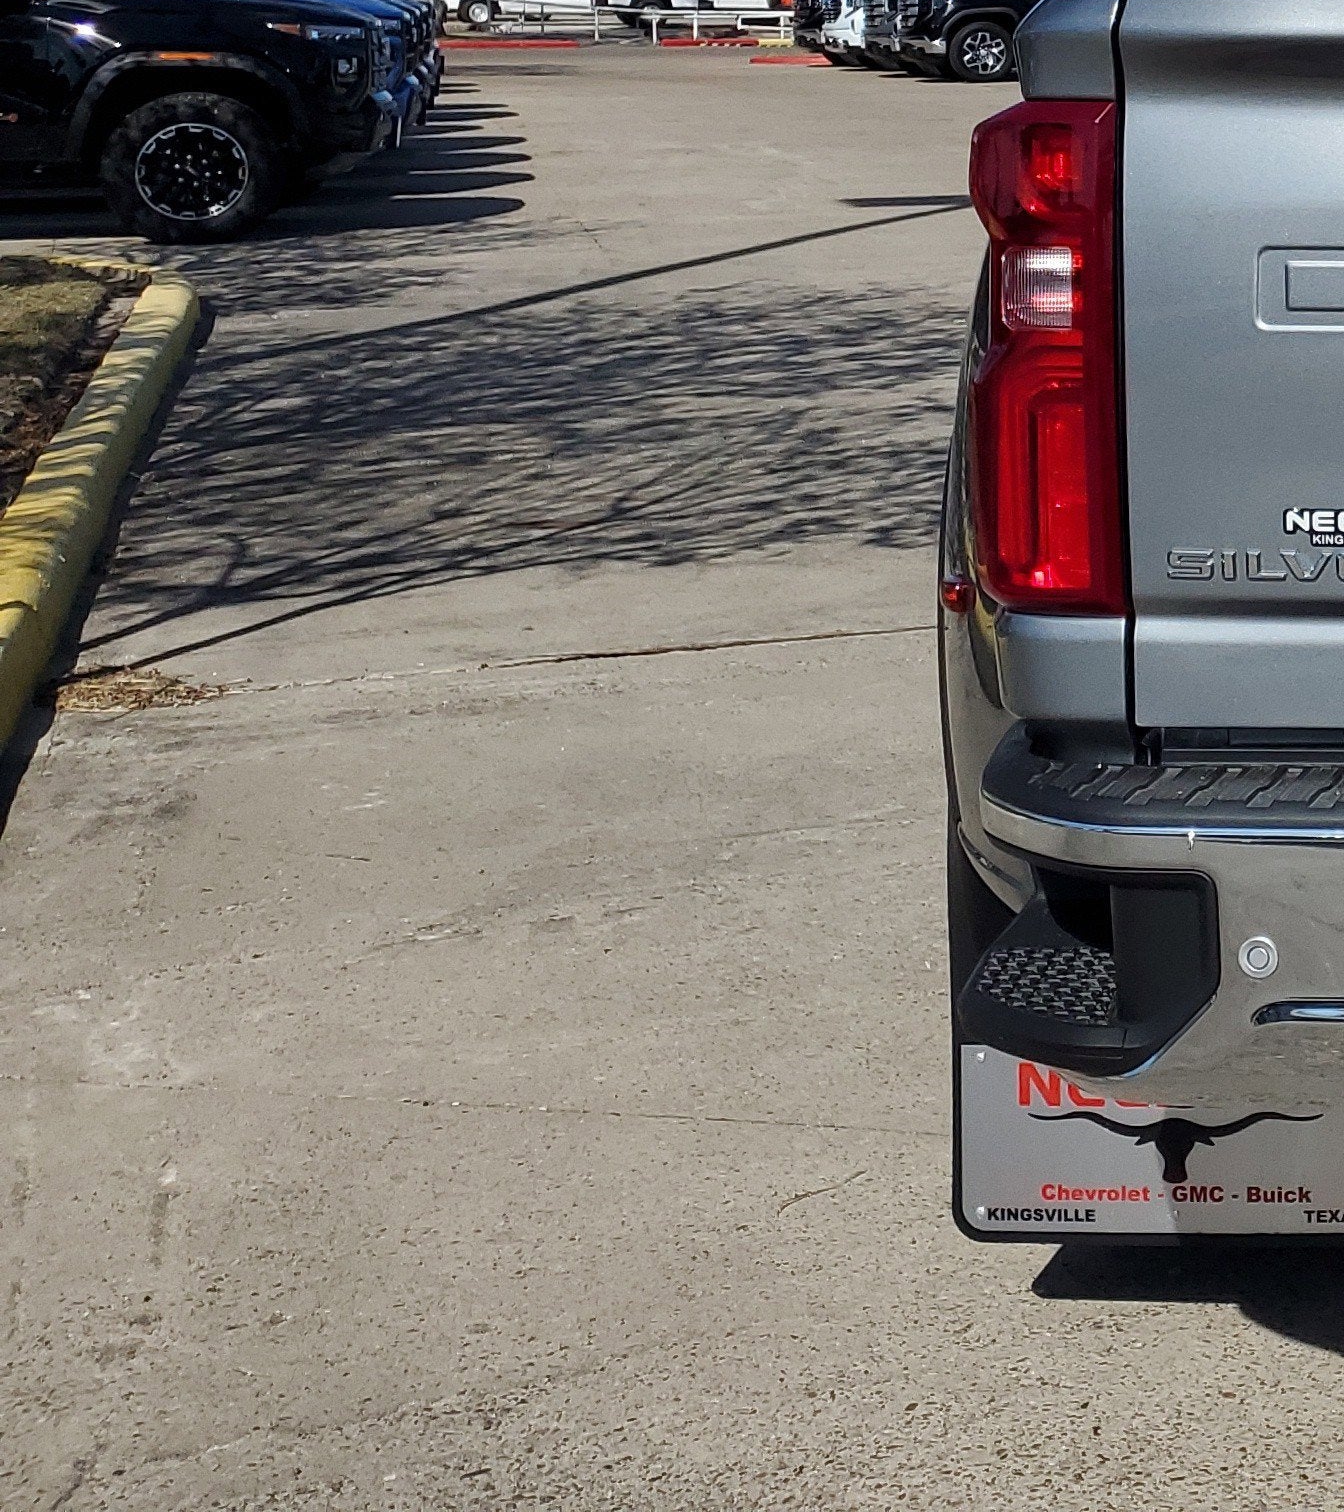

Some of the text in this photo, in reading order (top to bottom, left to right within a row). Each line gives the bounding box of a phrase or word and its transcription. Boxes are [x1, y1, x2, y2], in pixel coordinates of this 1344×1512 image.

[1041, 1184, 1151, 1202] Chevrolet
[1171, 1185, 1224, 1203] GMC
[1246, 1186, 1312, 1203] Buick
[987, 1206, 1097, 1223] KINGSVILLE
